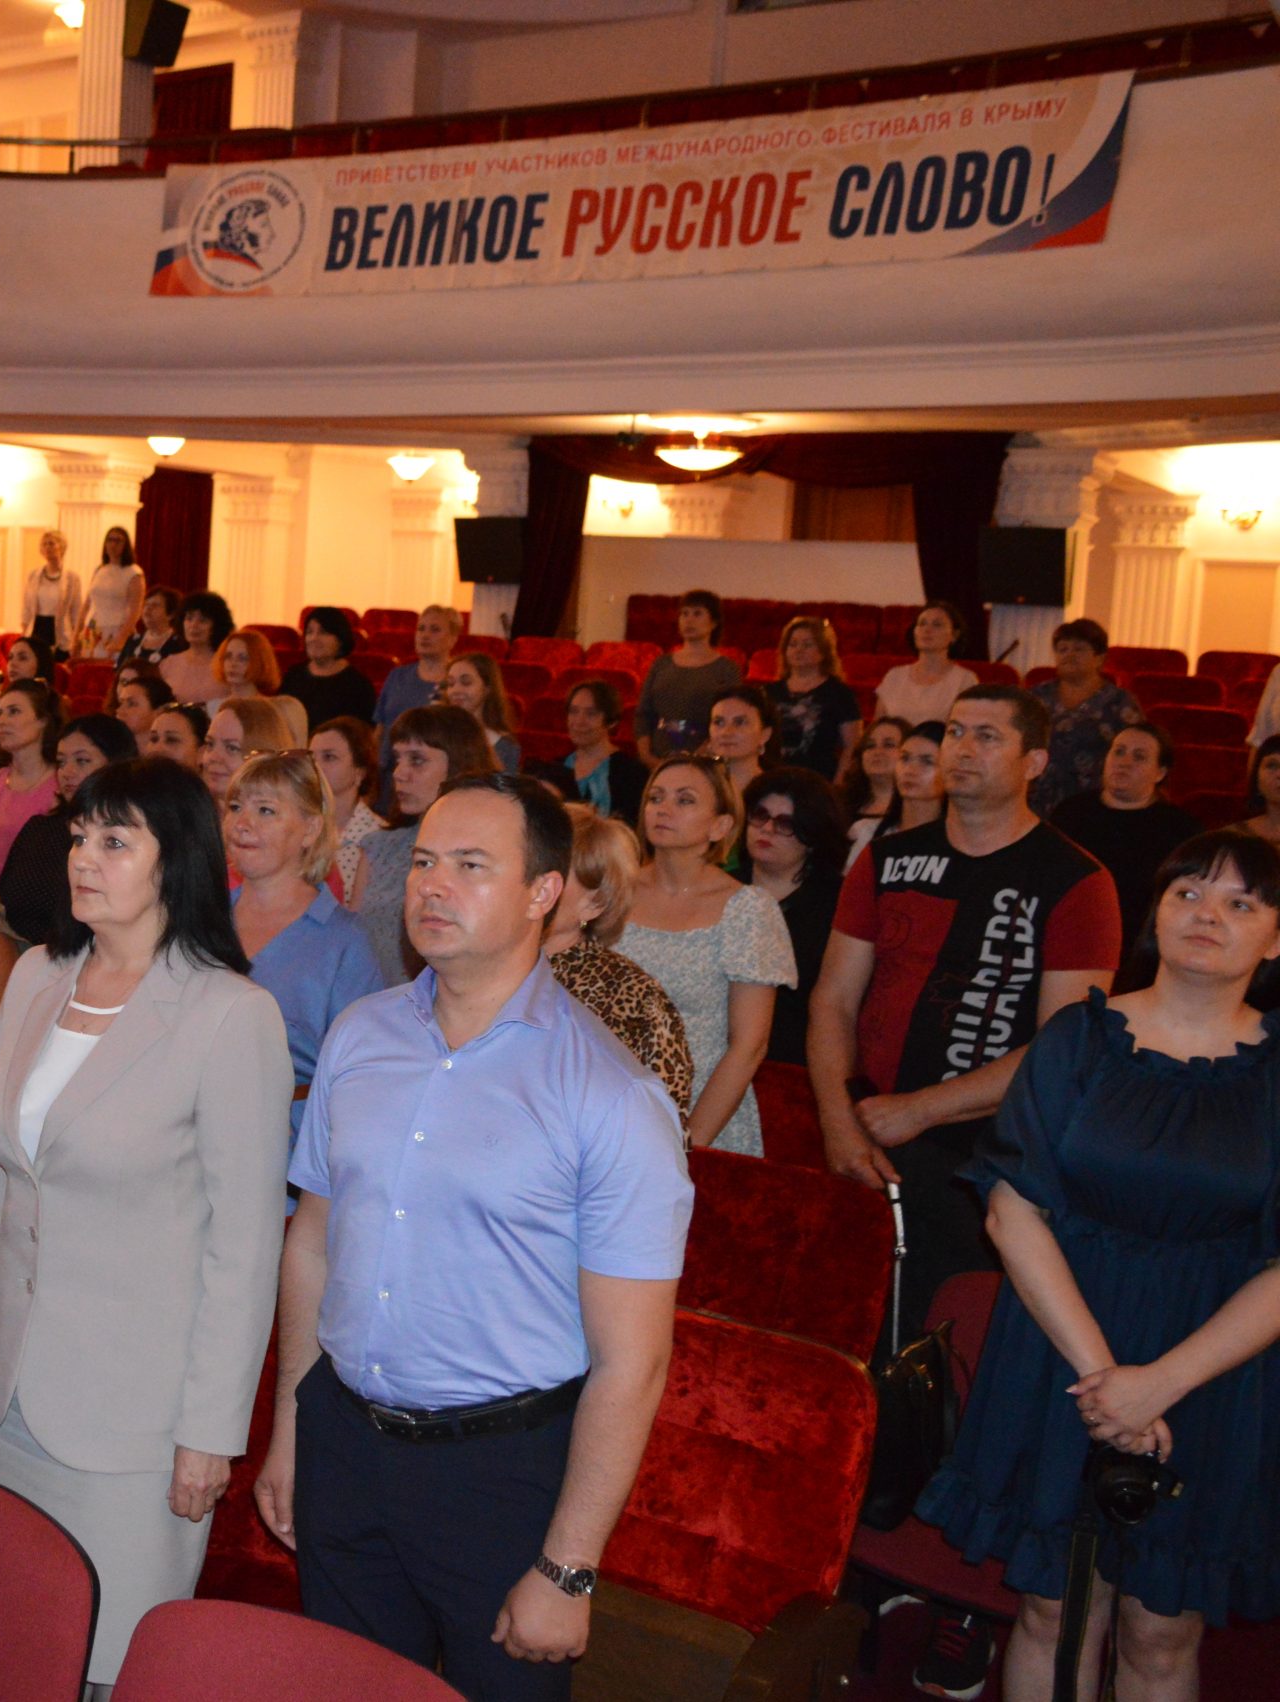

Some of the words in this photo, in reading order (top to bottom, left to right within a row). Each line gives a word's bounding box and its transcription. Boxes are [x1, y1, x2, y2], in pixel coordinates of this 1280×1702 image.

[336, 161, 477, 186] ПРИВЕТСТВУЕМ
[485, 147, 608, 176] УЧАСТНИКОВ
[616, 131, 812, 164] МЕЖДУНАРОДНОГО
[822, 113, 951, 146] ФЕСТИВАЛЯ
[960, 110, 974, 127] В
[984, 98, 1067, 126] КРЫМУ
[325, 194, 549, 271] ВЕЛИКОЕ
[563, 170, 813, 258] РУССКОЕ
[829, 145, 1055, 239] СЛОВО!
[881, 856, 949, 884] ICON
